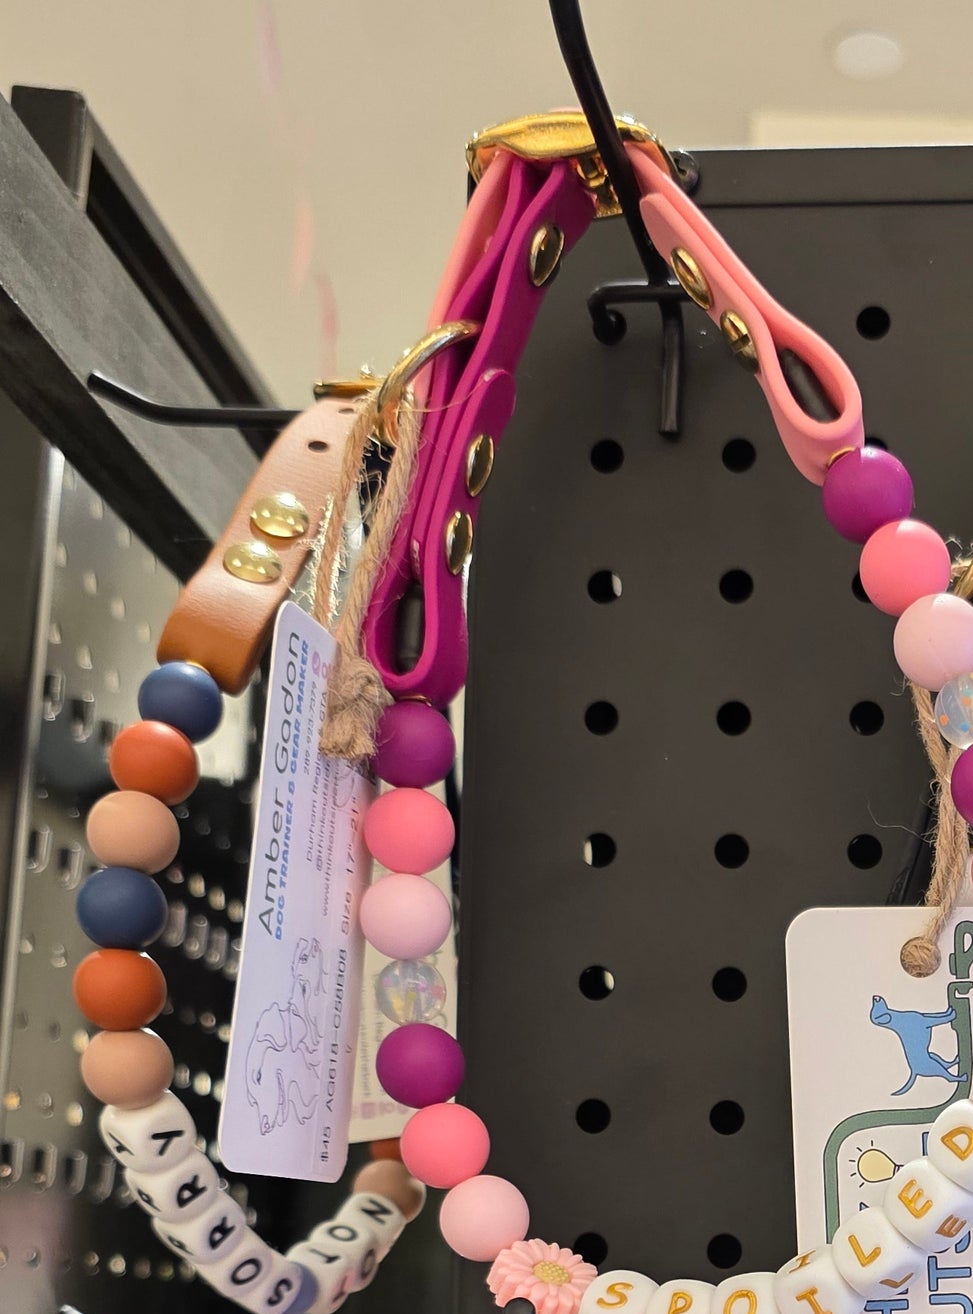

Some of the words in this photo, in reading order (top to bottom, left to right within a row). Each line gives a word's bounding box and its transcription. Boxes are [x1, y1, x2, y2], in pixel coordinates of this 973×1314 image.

[296, 639, 309, 714] MAKER
[258, 786, 284, 936] Amber
[275, 631, 300, 774] Gadon
[290, 718, 301, 774] GEAR
[279, 799, 294, 889] TRAINER
[306, 799, 318, 862] Durham
[275, 894, 285, 940] DOG
[320, 1126, 332, 1163] $45
[341, 891, 352, 935] Size
